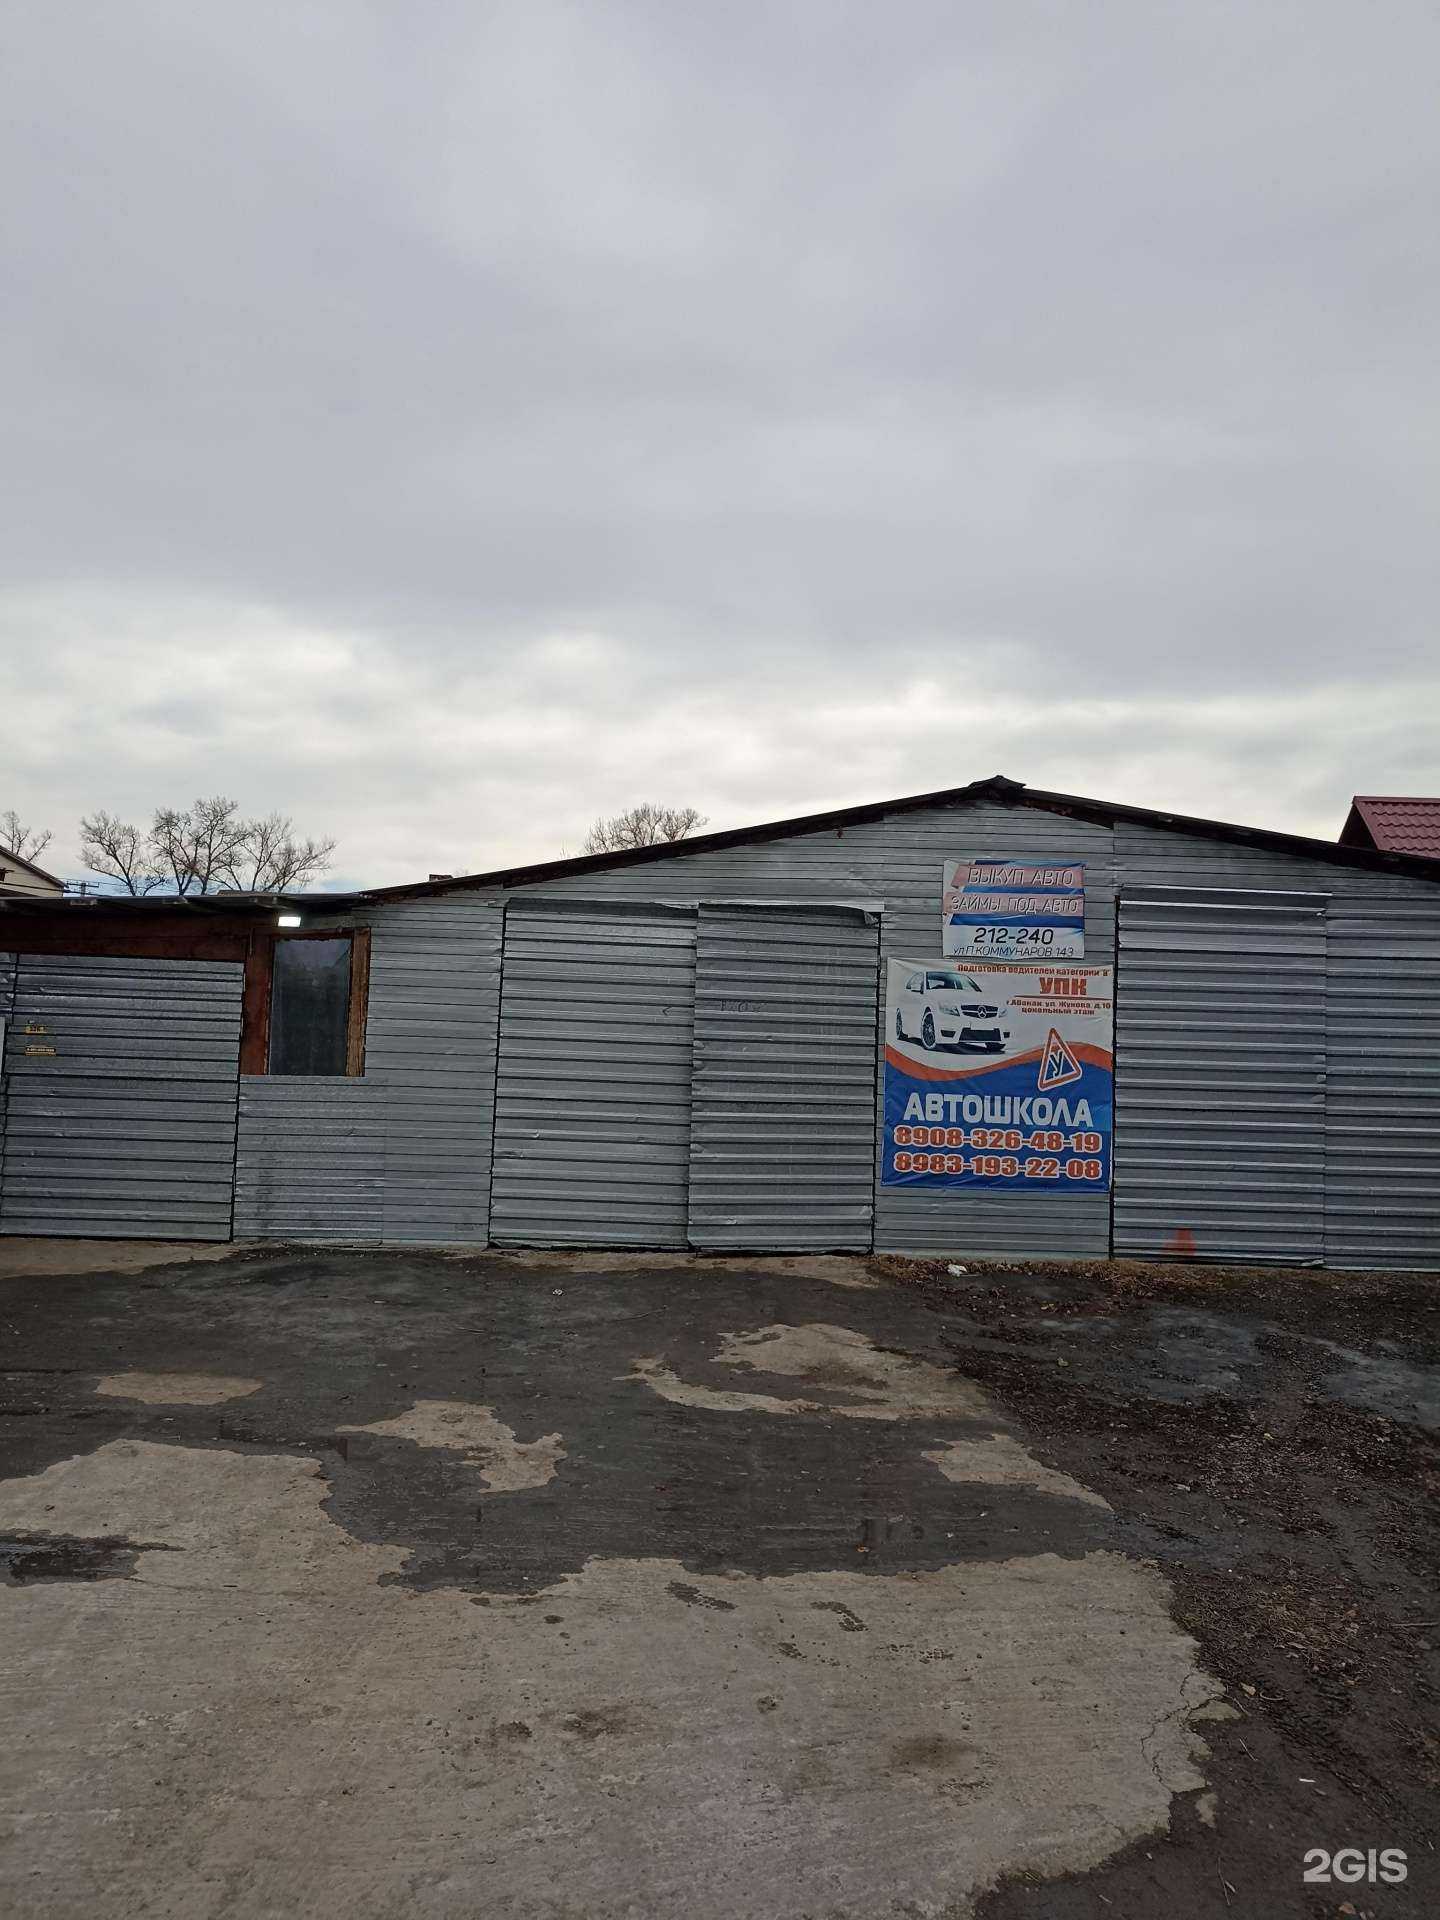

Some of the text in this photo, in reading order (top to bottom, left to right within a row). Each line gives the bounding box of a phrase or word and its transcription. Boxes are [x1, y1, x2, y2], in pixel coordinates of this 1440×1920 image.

[968, 867, 1074, 886] ВЫКУП АВТО
[951, 895, 1079, 915] ЗАЙМЫ ПОД АВТО
[973, 927, 1054, 945] 212-240
[1056, 947, 1074, 957] 143
[957, 964, 1007, 973] Подготовка
[1039, 977, 1087, 996] УПК
[903, 1093, 1094, 1127] АВТОШКОЛА
[894, 1125, 1102, 1153] 8908-326-48-19
[894, 1152, 1102, 1179] 8983-193-22-08
